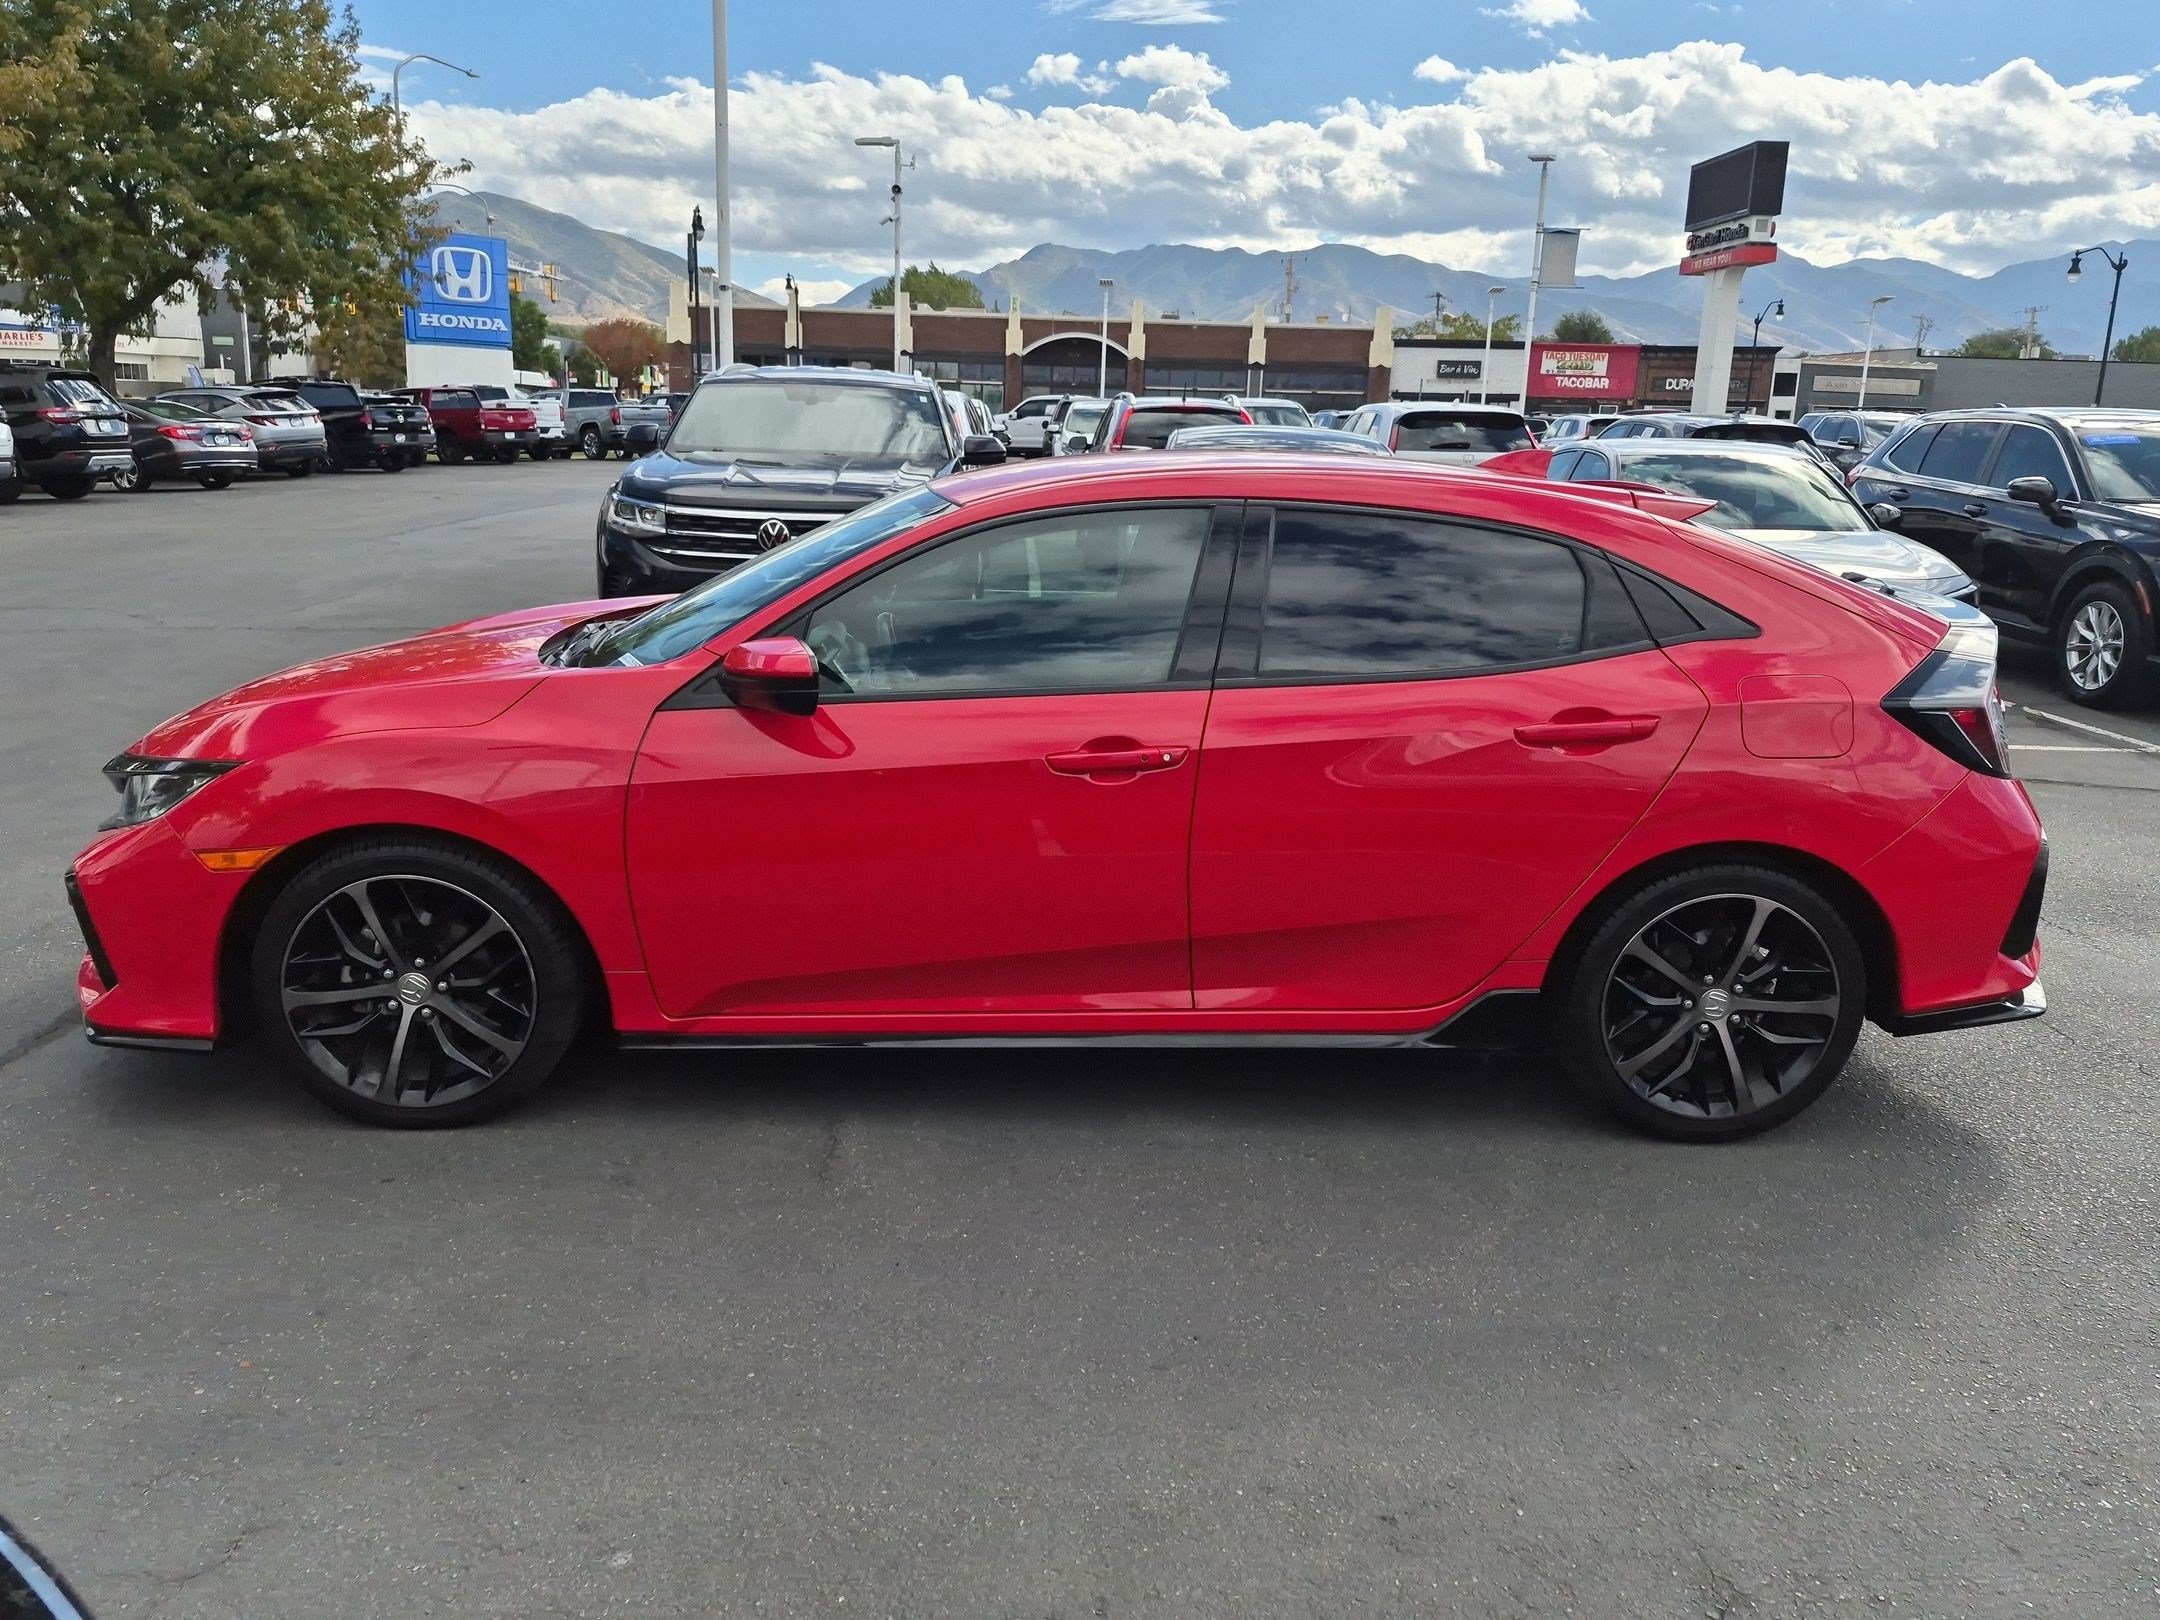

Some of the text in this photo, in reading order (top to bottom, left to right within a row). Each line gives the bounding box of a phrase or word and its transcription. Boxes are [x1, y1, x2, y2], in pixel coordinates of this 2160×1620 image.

[418, 312, 509, 332] HONDA
[0, 332, 44, 341] ARLIE'S
[1545, 351, 1607, 362] TACO TUESDAY
[1440, 364, 1455, 374] Bar
[1555, 376, 1610, 389] TACOBAR
[1665, 378, 1695, 390] DURA
